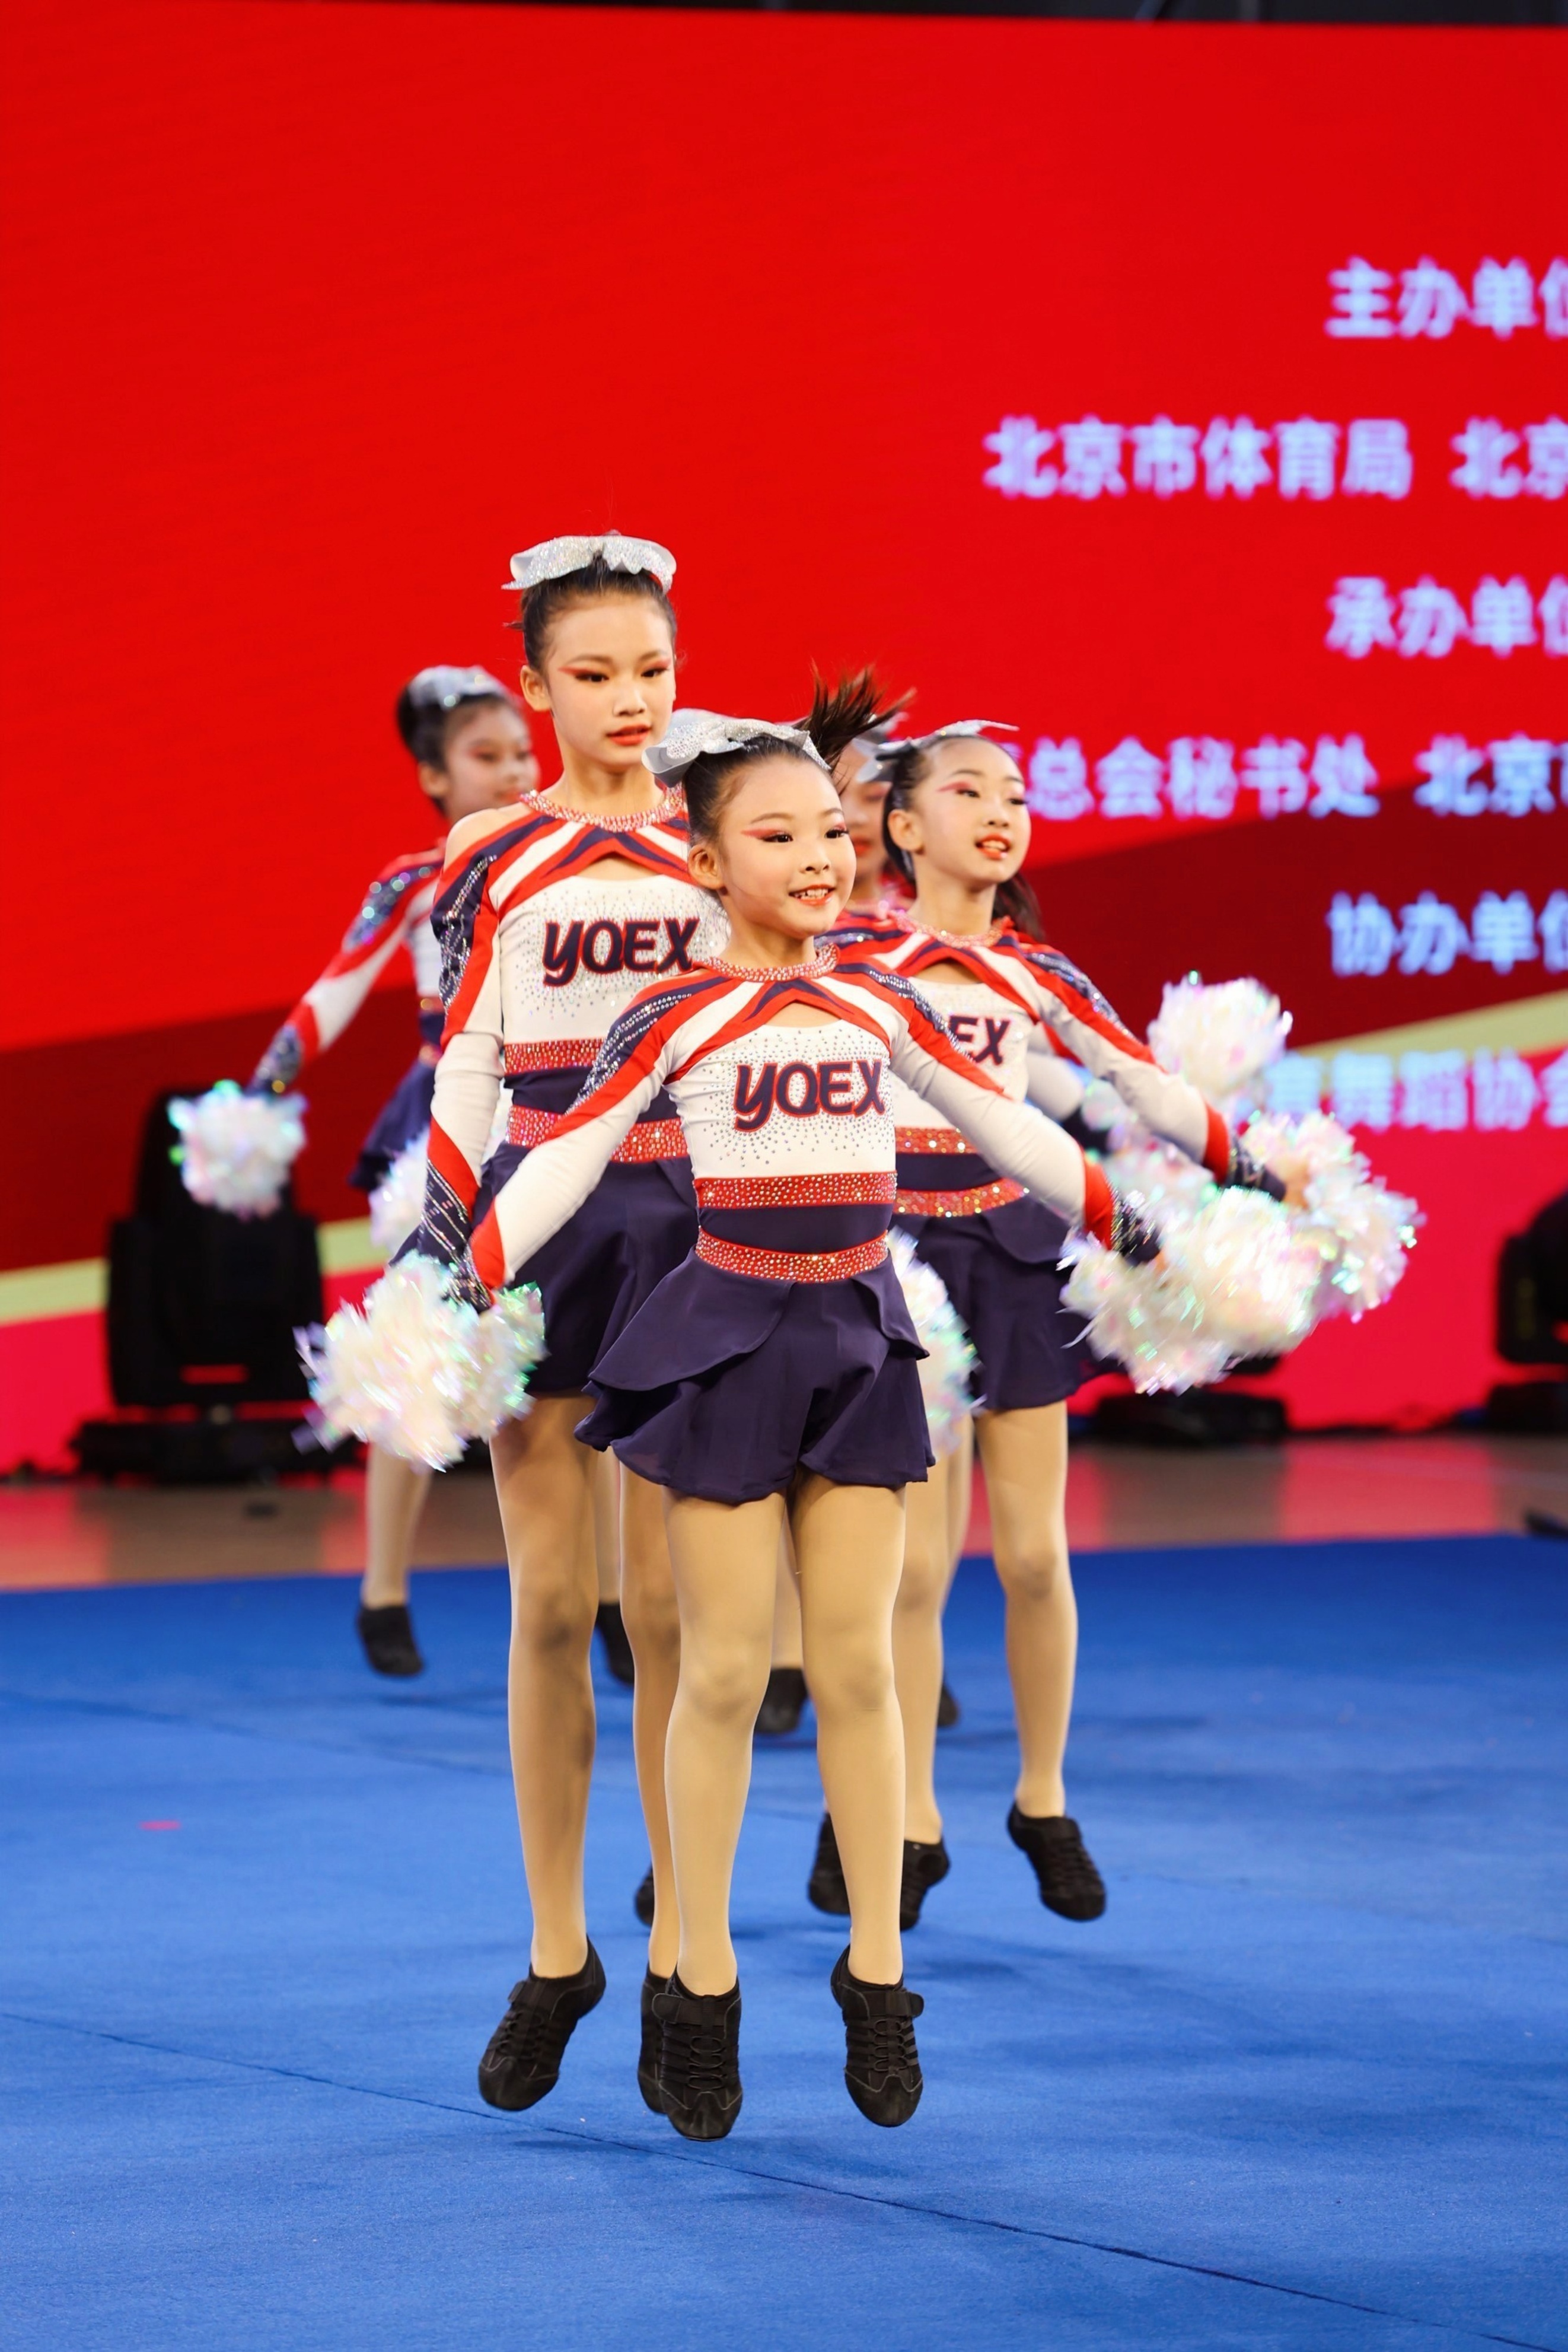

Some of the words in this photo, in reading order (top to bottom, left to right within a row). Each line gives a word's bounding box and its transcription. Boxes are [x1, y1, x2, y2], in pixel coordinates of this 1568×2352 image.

[982, 413, 1413, 500] 北京市体育局
[1003, 733, 1380, 819] 总会秘书处
[1413, 731, 1568, 818] 北京
